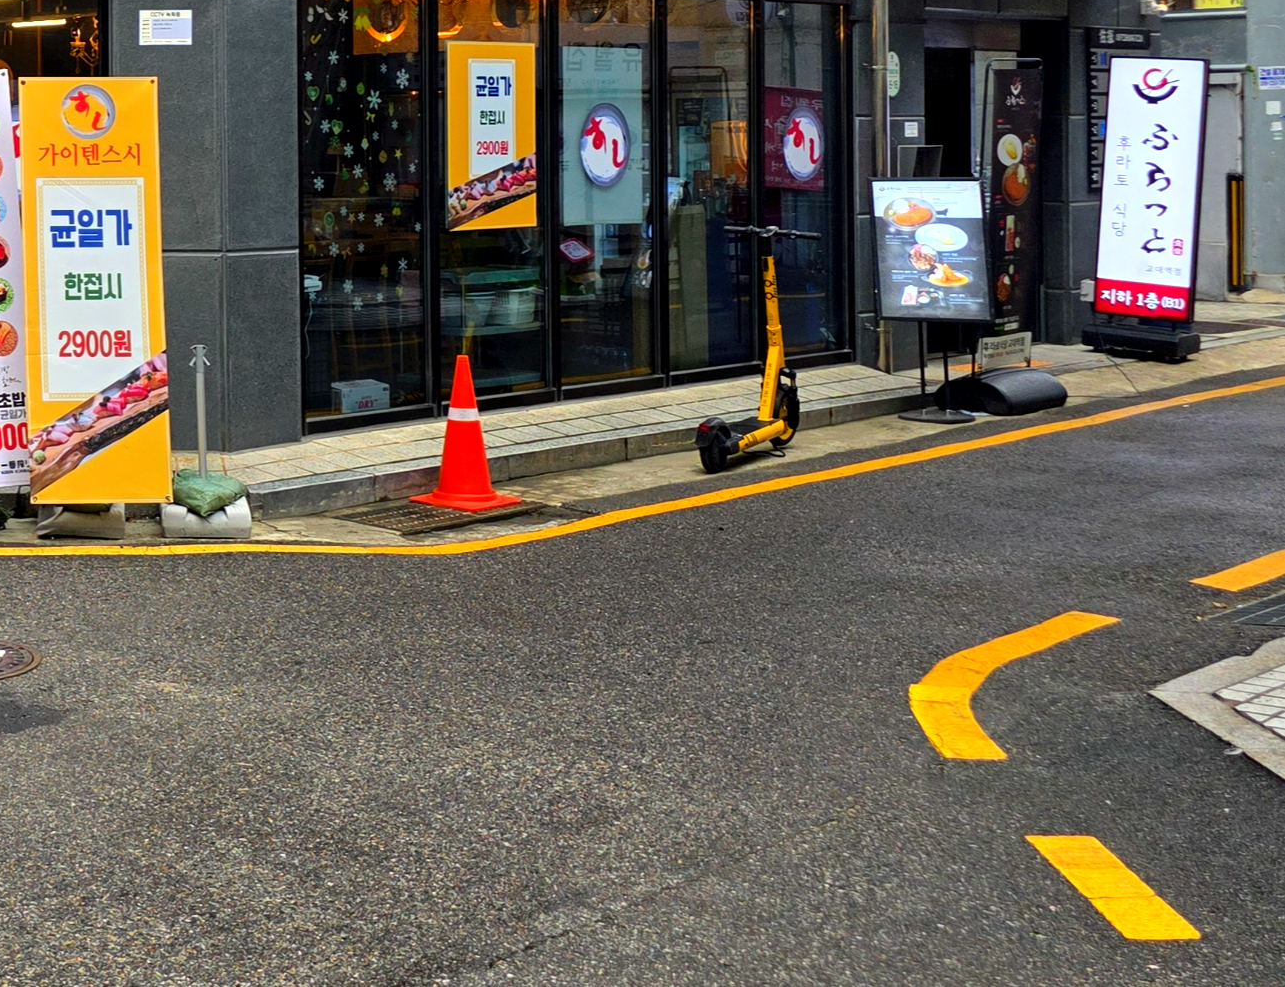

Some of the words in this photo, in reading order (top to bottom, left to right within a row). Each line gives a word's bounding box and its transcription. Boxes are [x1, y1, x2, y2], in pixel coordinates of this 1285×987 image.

[475, 76, 512, 97] 균일가
[479, 109, 505, 125] 한접시
[38, 142, 141, 166] 가이텐스시
[476, 140, 509, 155] 2900원
[1114, 135, 1132, 187] 후라토
[1140, 123, 1179, 254] ふらっと
[50, 209, 133, 248] 균일가
[1111, 203, 1128, 237] 식당
[64, 272, 123, 301] 한접시
[1100, 288, 1133, 306] 지하
[58, 329, 133, 358] 2900원
[0, 409, 27, 421] 균일가
